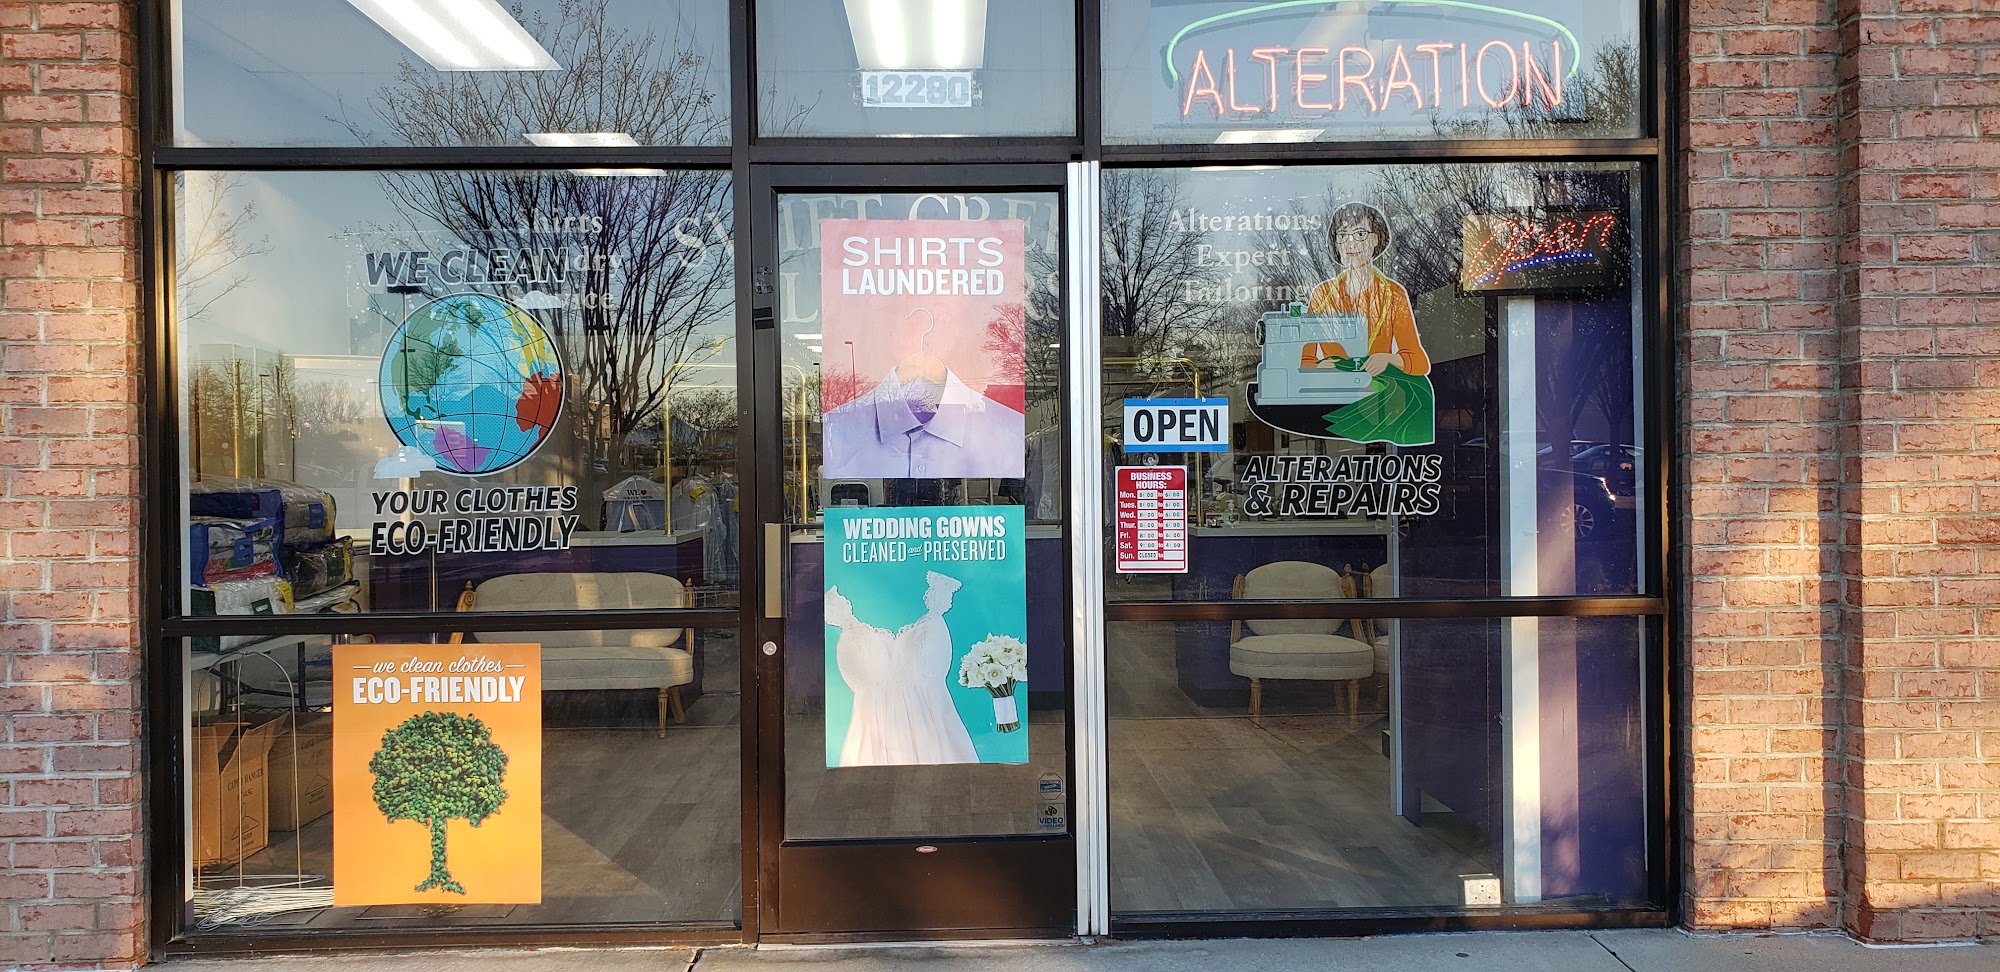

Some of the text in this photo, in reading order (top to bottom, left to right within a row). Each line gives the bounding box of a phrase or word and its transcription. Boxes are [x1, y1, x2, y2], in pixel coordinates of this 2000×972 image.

[866, 74, 970, 105] 12280
[1183, 39, 1562, 116] ALTERATION
[1166, 207, 1322, 233] Alterations
[842, 236, 1004, 267] SHIRTS
[1196, 244, 1291, 274] Expert
[365, 250, 430, 287] WE
[438, 247, 568, 286] CLEAN
[842, 268, 1004, 296] LAUNDERED
[1133, 409, 1219, 442] OPEN
[1130, 472, 1172, 480] BUSINESS
[1240, 453, 1443, 483] ALTERATIONS
[1120, 490, 1136, 499] Mon.
[1135, 481, 1167, 489] HOURS:
[1243, 482, 1443, 516] & REPAIRS
[371, 485, 579, 516] YOUR CLOTHES
[1120, 501, 1137, 509] Tues.
[369, 515, 580, 556] ECO-FRIENDLY
[843, 515, 1006, 540] WEDDING GOWNS
[842, 539, 1006, 563] CLEANED and PRESERVED
[373, 655, 504, 673] we clean clothes
[353, 675, 526, 704] ECO-FRIENDLY
